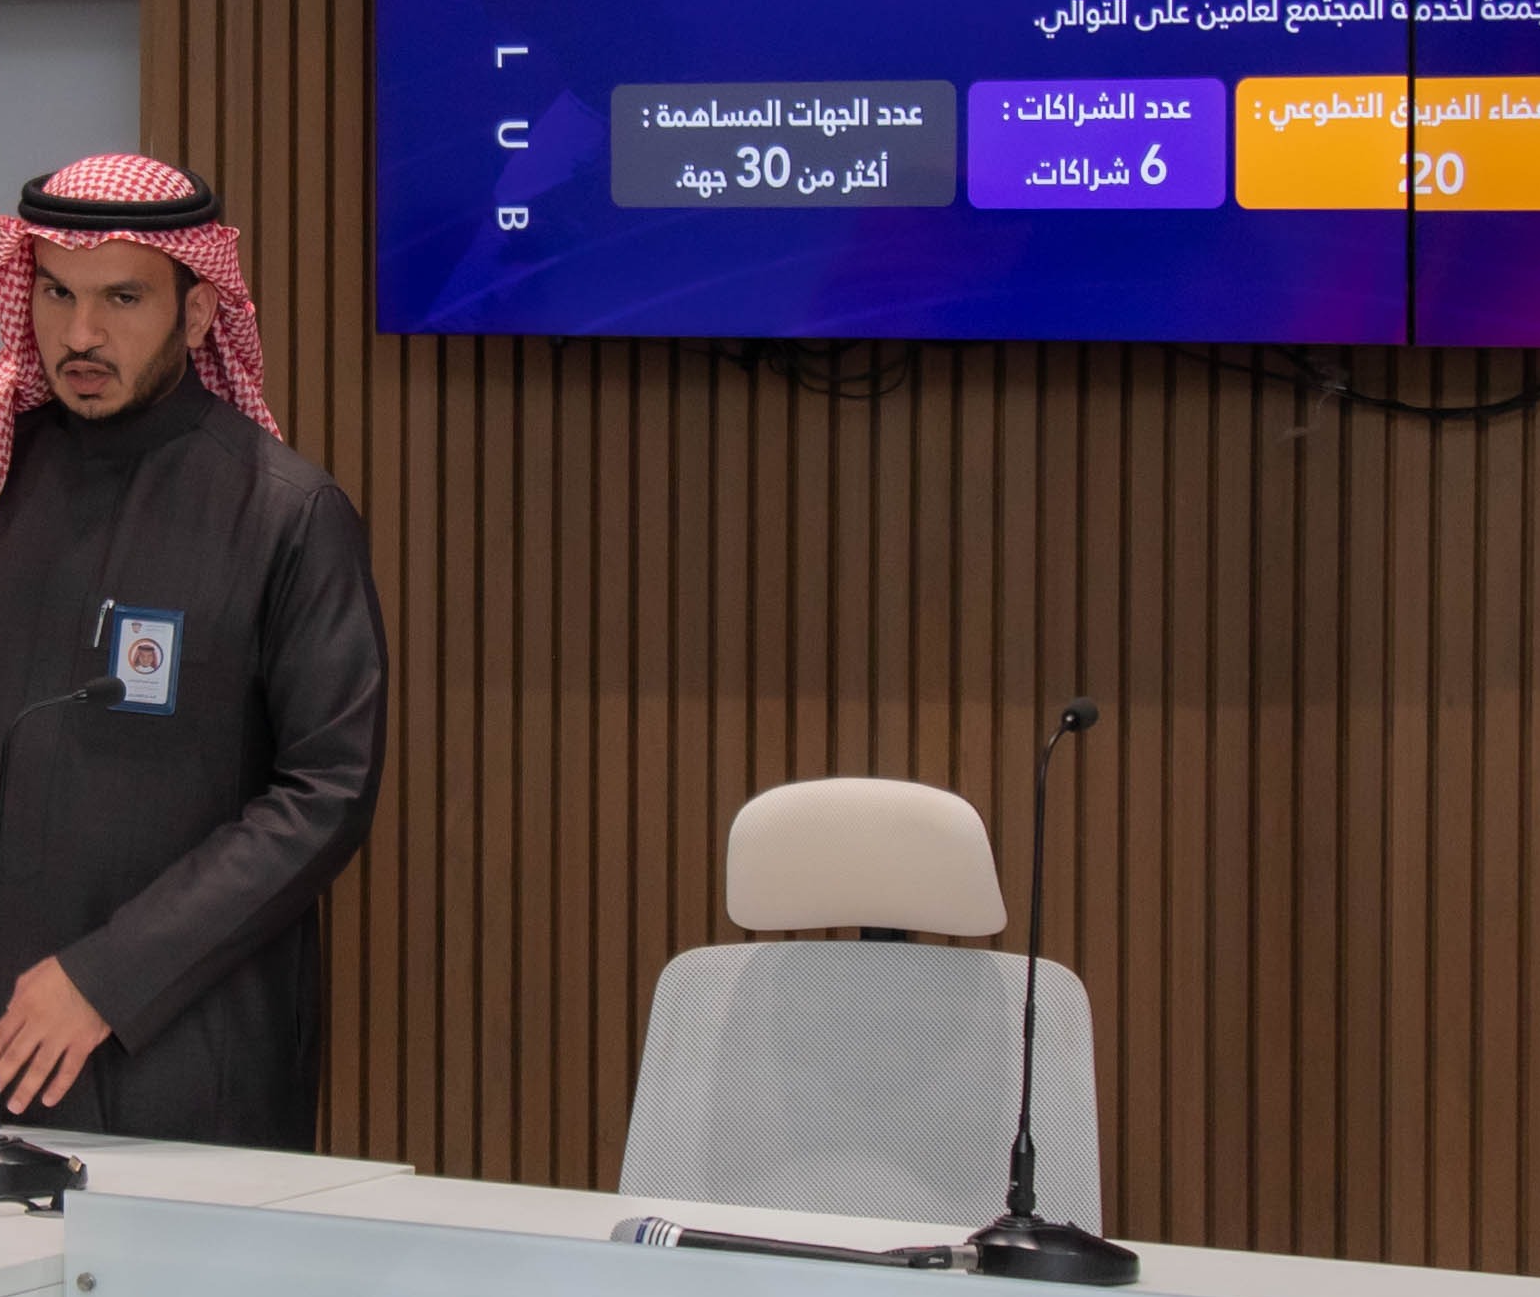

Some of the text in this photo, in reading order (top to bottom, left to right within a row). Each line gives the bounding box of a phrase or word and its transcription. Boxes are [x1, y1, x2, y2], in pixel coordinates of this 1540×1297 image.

[656, 99, 782, 128] المساهمة
[787, 98, 869, 137] الجهات
[876, 106, 923, 126] عدد
[1017, 91, 1135, 128] الشراكات
[1143, 100, 1192, 119] عدد
[1268, 91, 1384, 132] التطوعي
[1389, 93, 1482, 129] الفريق
[675, 145, 888, 199] أكثر من 30 جهة.
[1025, 143, 1167, 192] 6 شراكات.
[1398, 151, 1466, 195] 20
